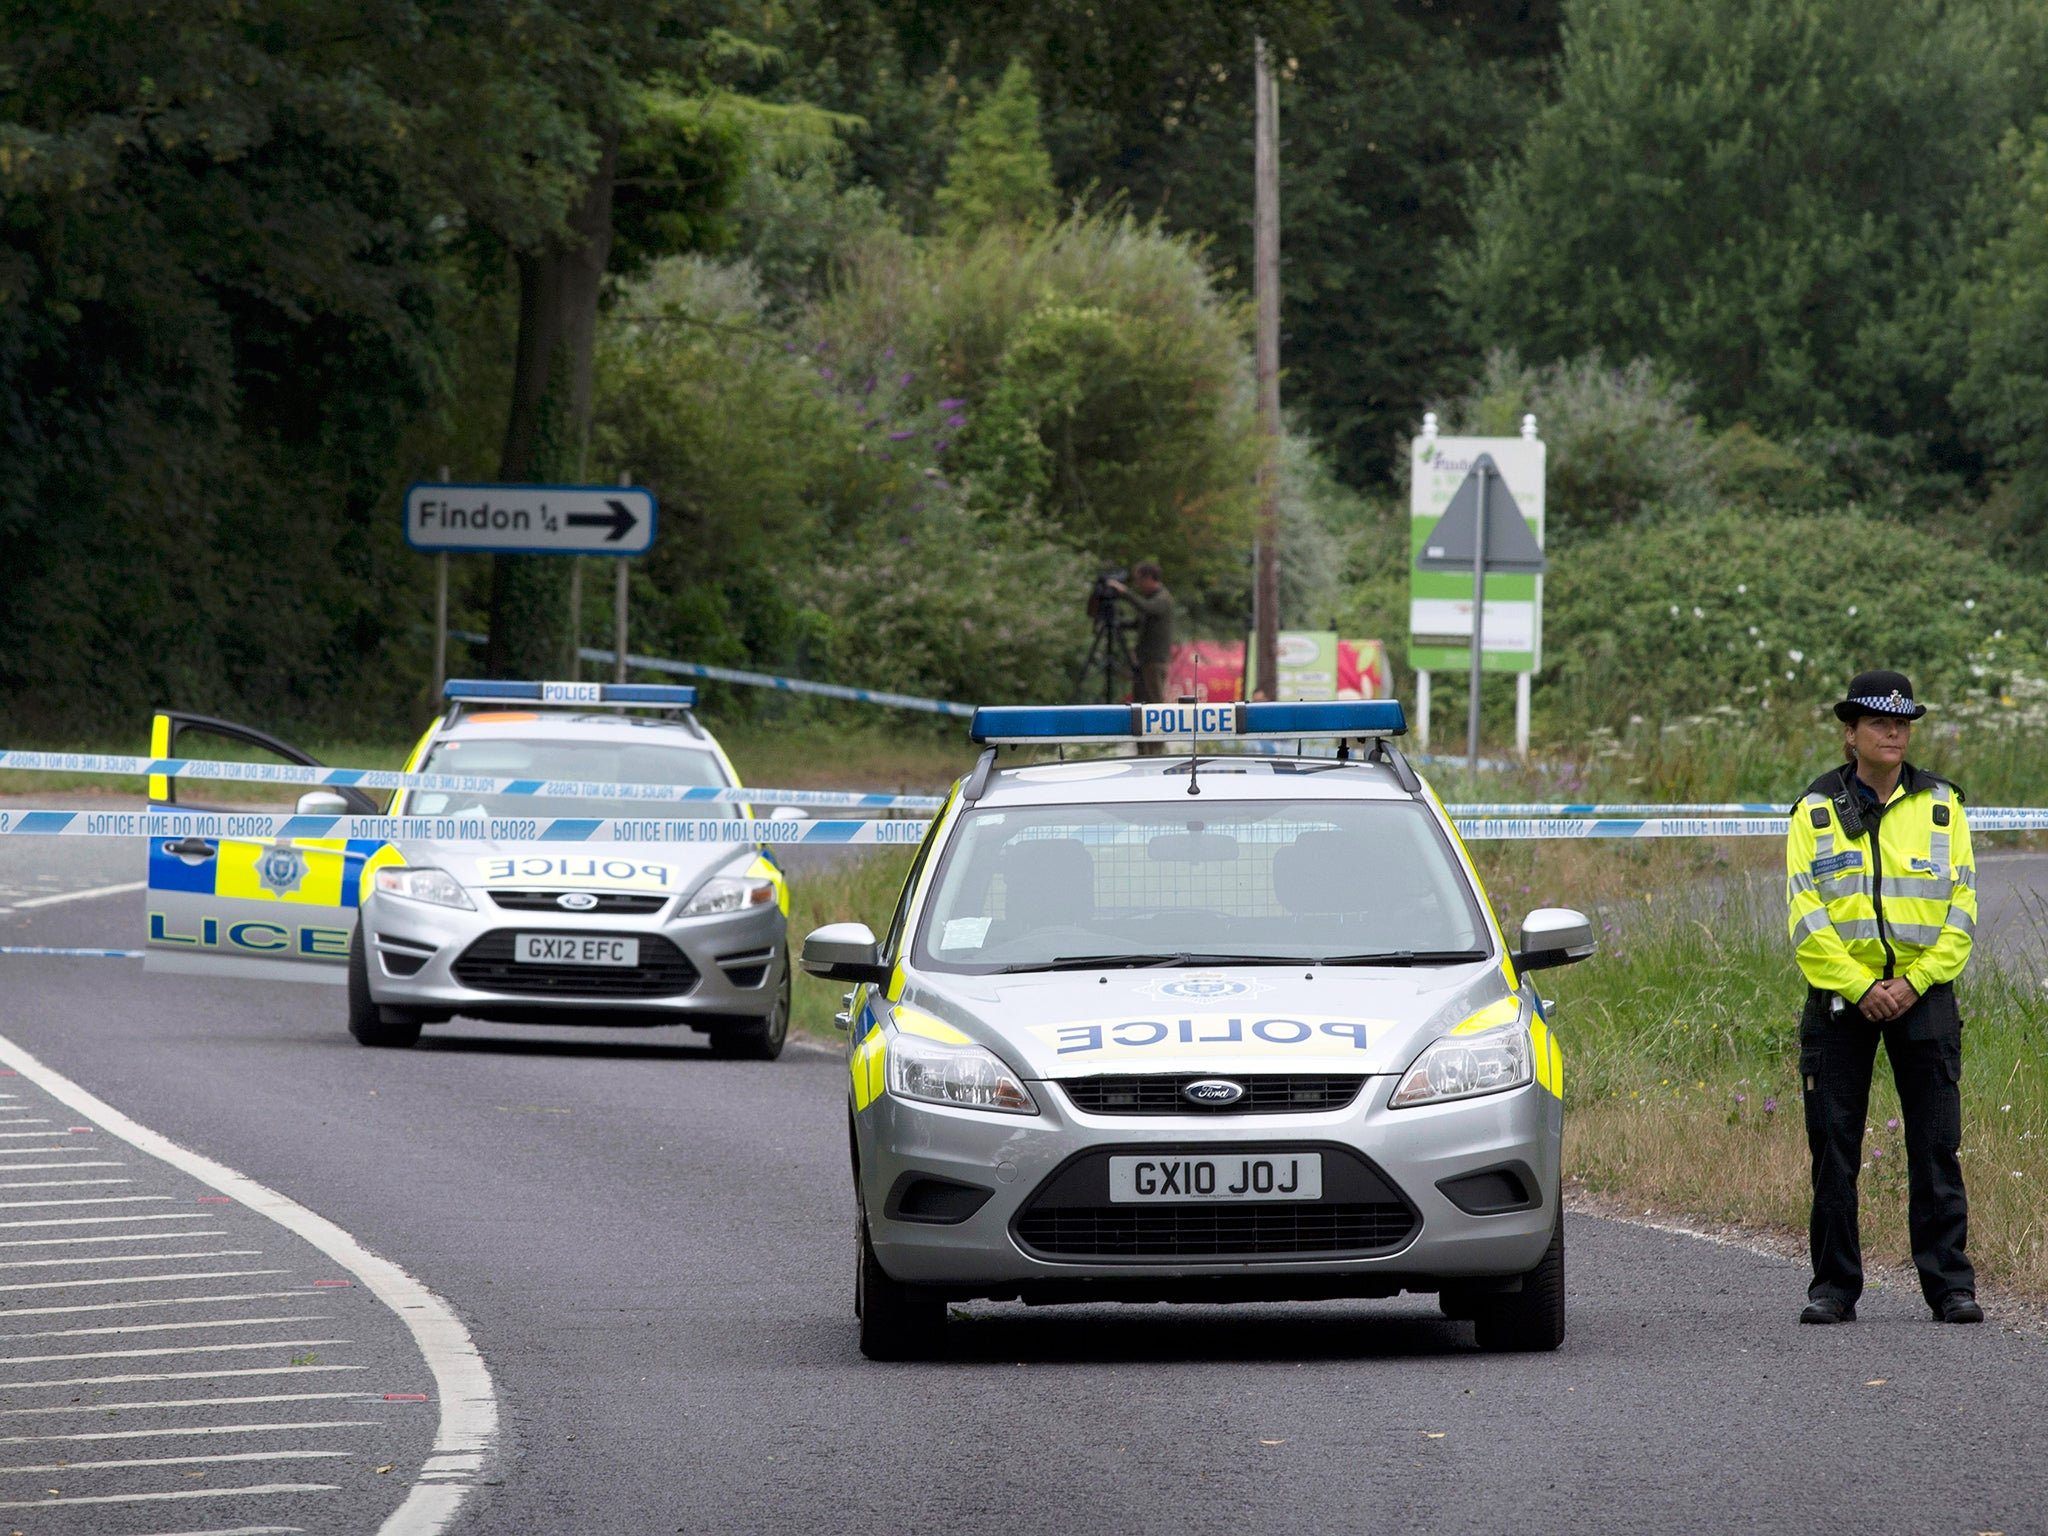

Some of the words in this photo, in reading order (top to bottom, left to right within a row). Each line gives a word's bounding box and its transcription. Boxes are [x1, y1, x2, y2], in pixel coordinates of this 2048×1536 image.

[419, 501, 530, 529] Findon
[545, 685, 597, 701] POLICE
[1145, 708, 1233, 734] POLICE
[529, 938, 577, 961] GX12
[582, 940, 624, 962] EFC
[1198, 1085, 1230, 1099] Ford
[1135, 1162, 1215, 1195] GX10
[1228, 1160, 1298, 1193] JOJ
